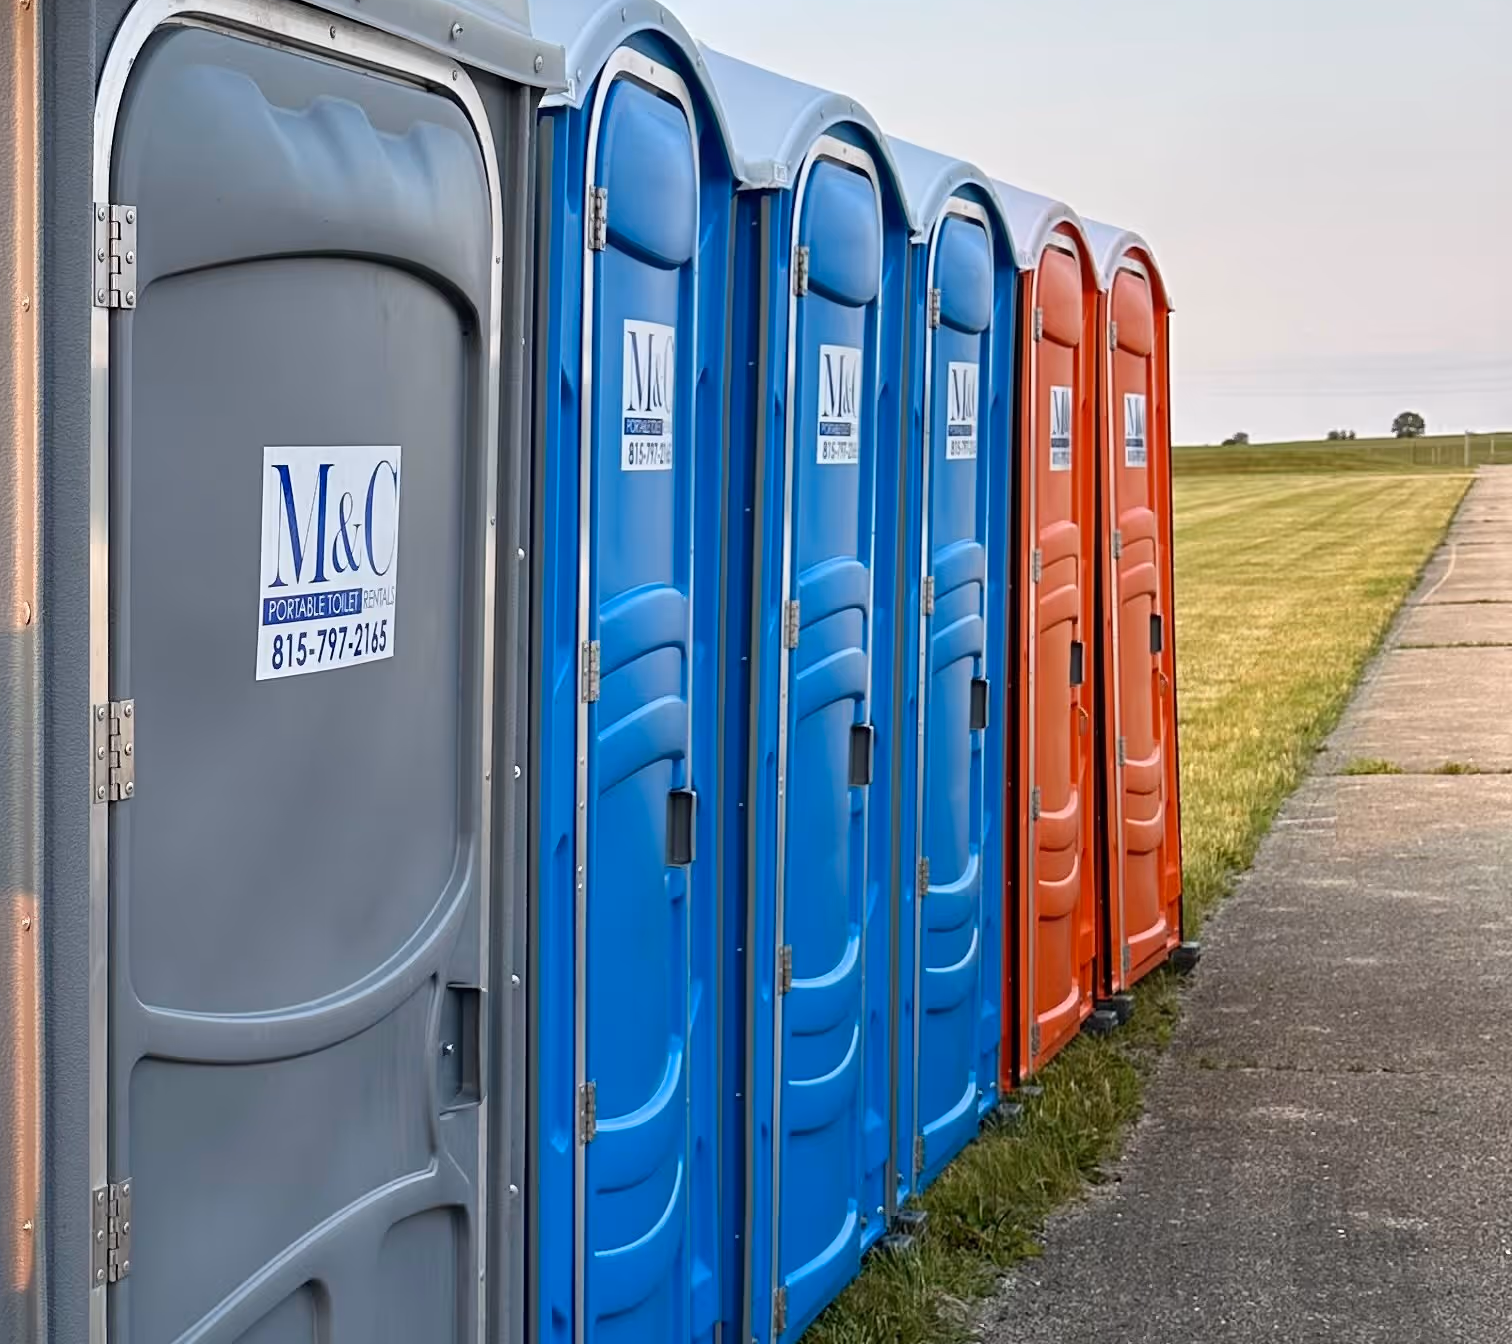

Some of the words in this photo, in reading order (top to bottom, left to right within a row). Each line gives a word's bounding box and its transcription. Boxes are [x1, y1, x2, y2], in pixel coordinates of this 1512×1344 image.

[626, 330, 674, 413] M&C
[268, 459, 398, 588] M&C
[268, 594, 325, 622] PORTABLE
[328, 590, 360, 615] TOILET
[363, 585, 395, 610] RENTALS
[271, 618, 388, 670] 815-797-2165
